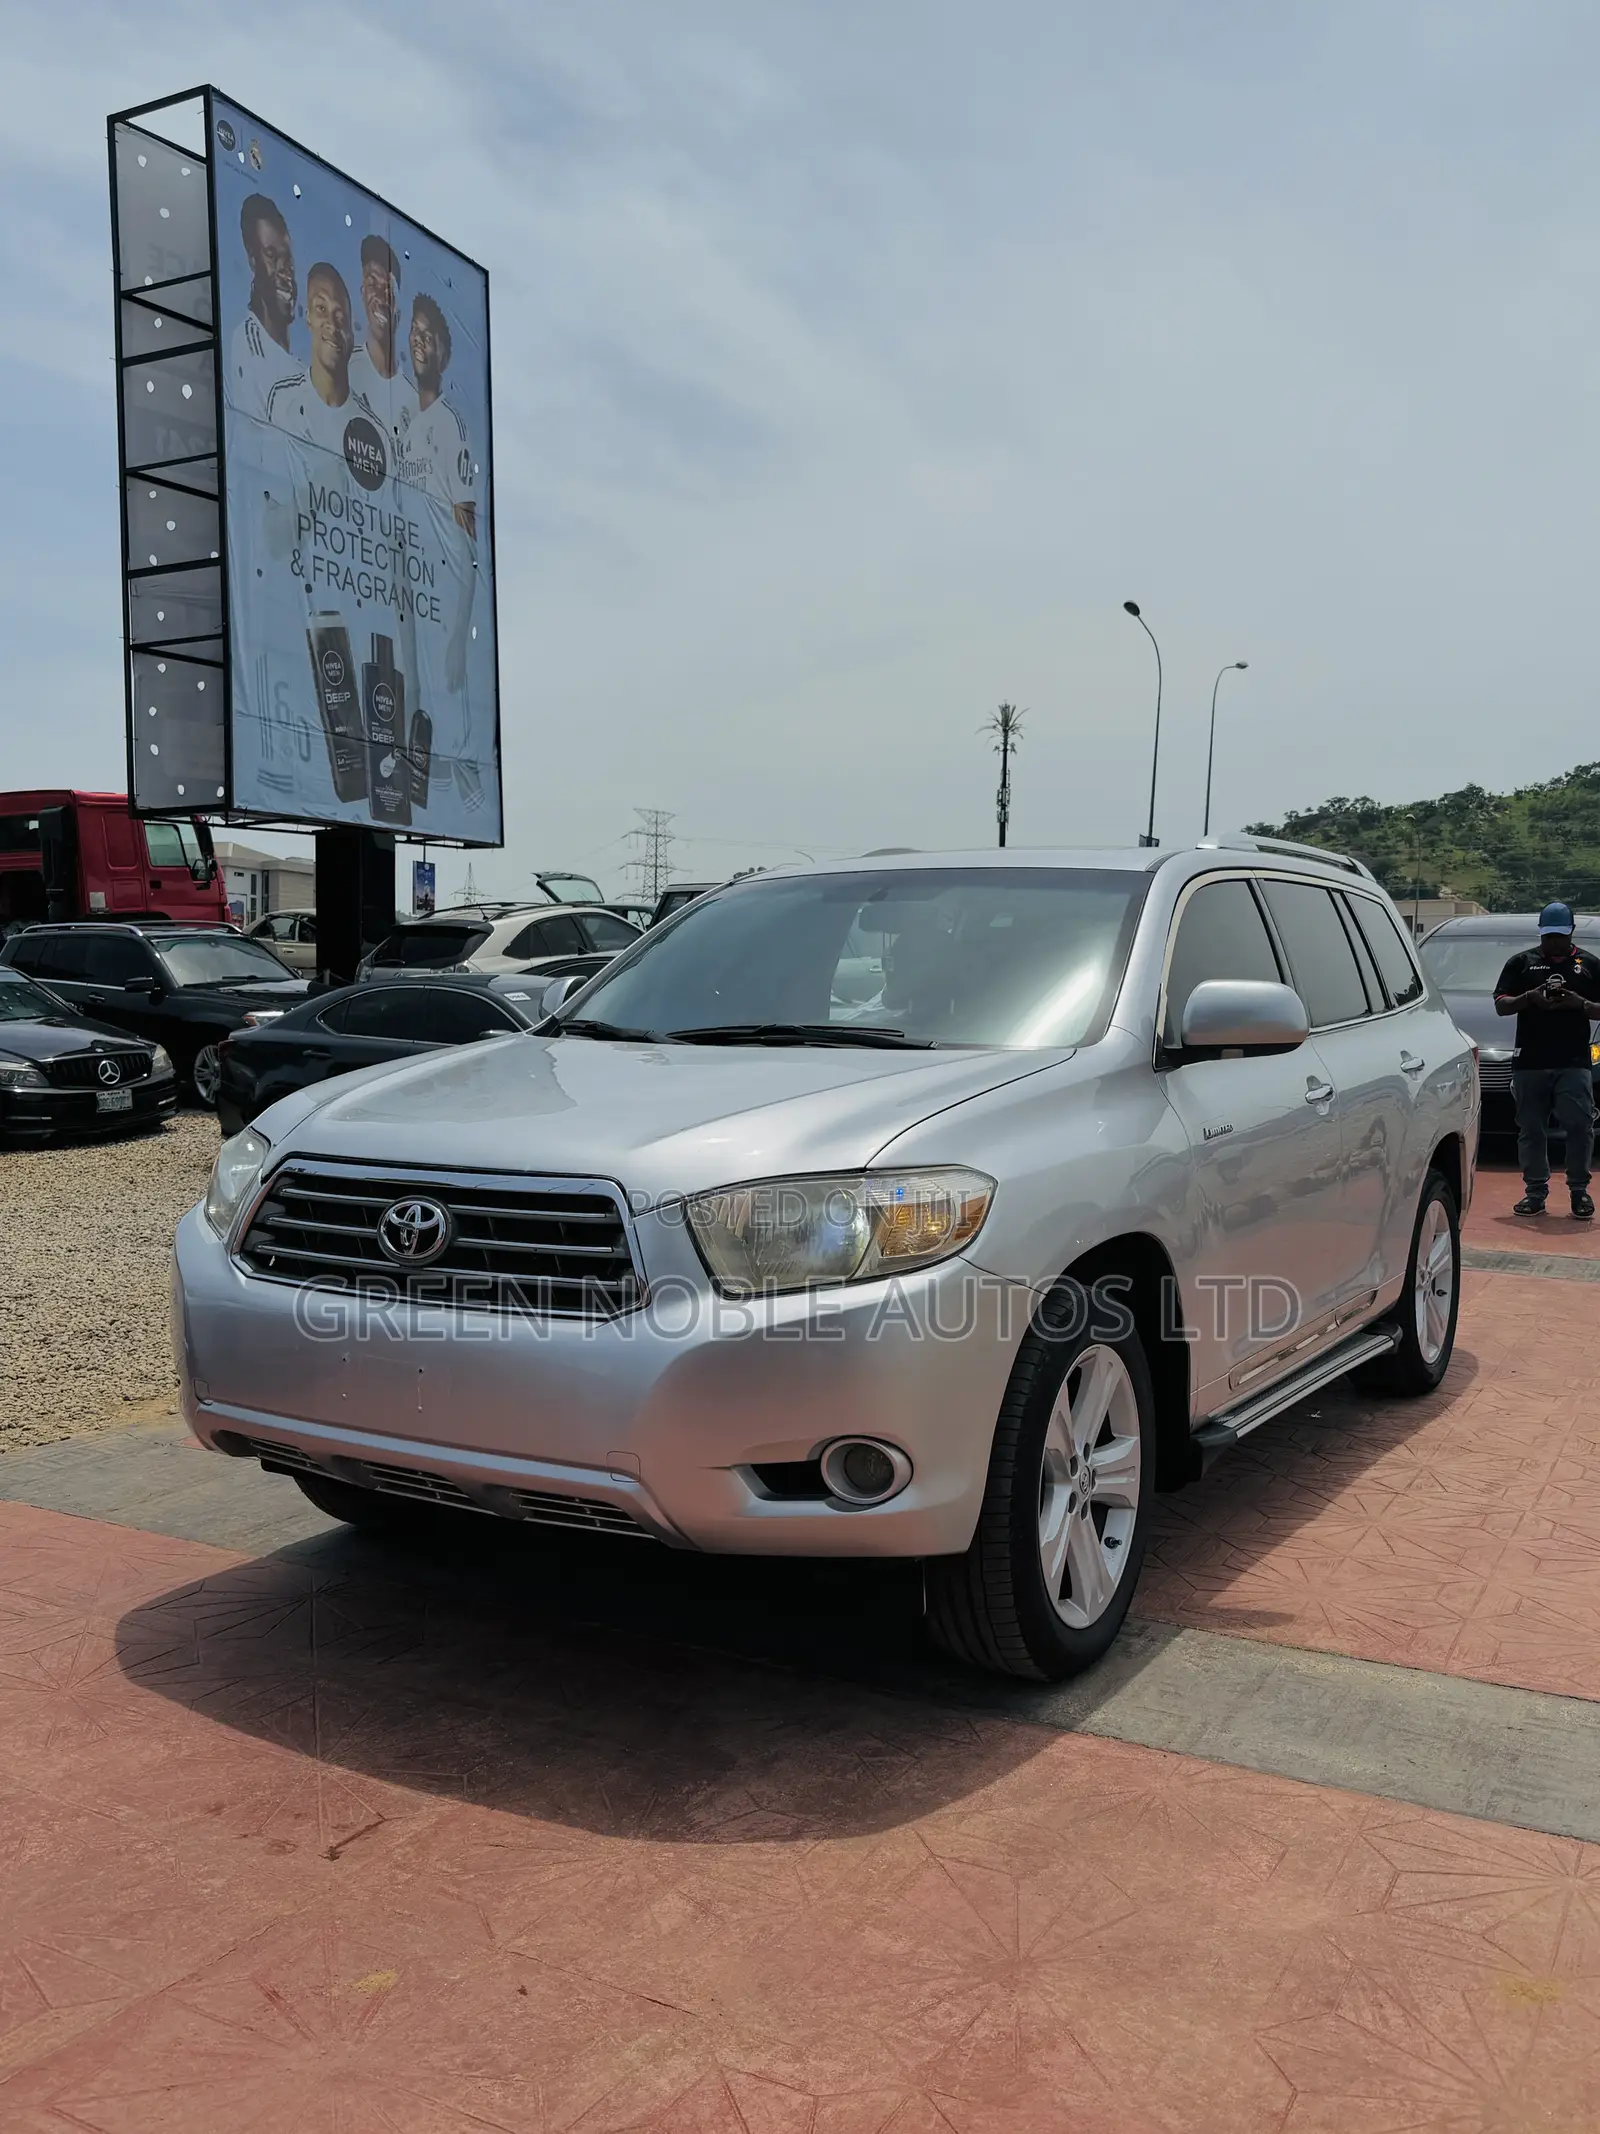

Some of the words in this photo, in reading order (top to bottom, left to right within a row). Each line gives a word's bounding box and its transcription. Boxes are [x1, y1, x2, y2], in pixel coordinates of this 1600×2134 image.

[347, 436, 384, 465] NIVEA
[352, 455, 379, 477] MEN
[309, 481, 424, 556] MOISTURE,
[298, 513, 435, 589] PROTECTION
[290, 548, 305, 578] &
[312, 555, 441, 623] FRAGRANCE
[326, 692, 350, 703] DEEP
[376, 695, 393, 705] NIVEA
[379, 704, 391, 712] MEN
[372, 732, 394, 742] DEEP
